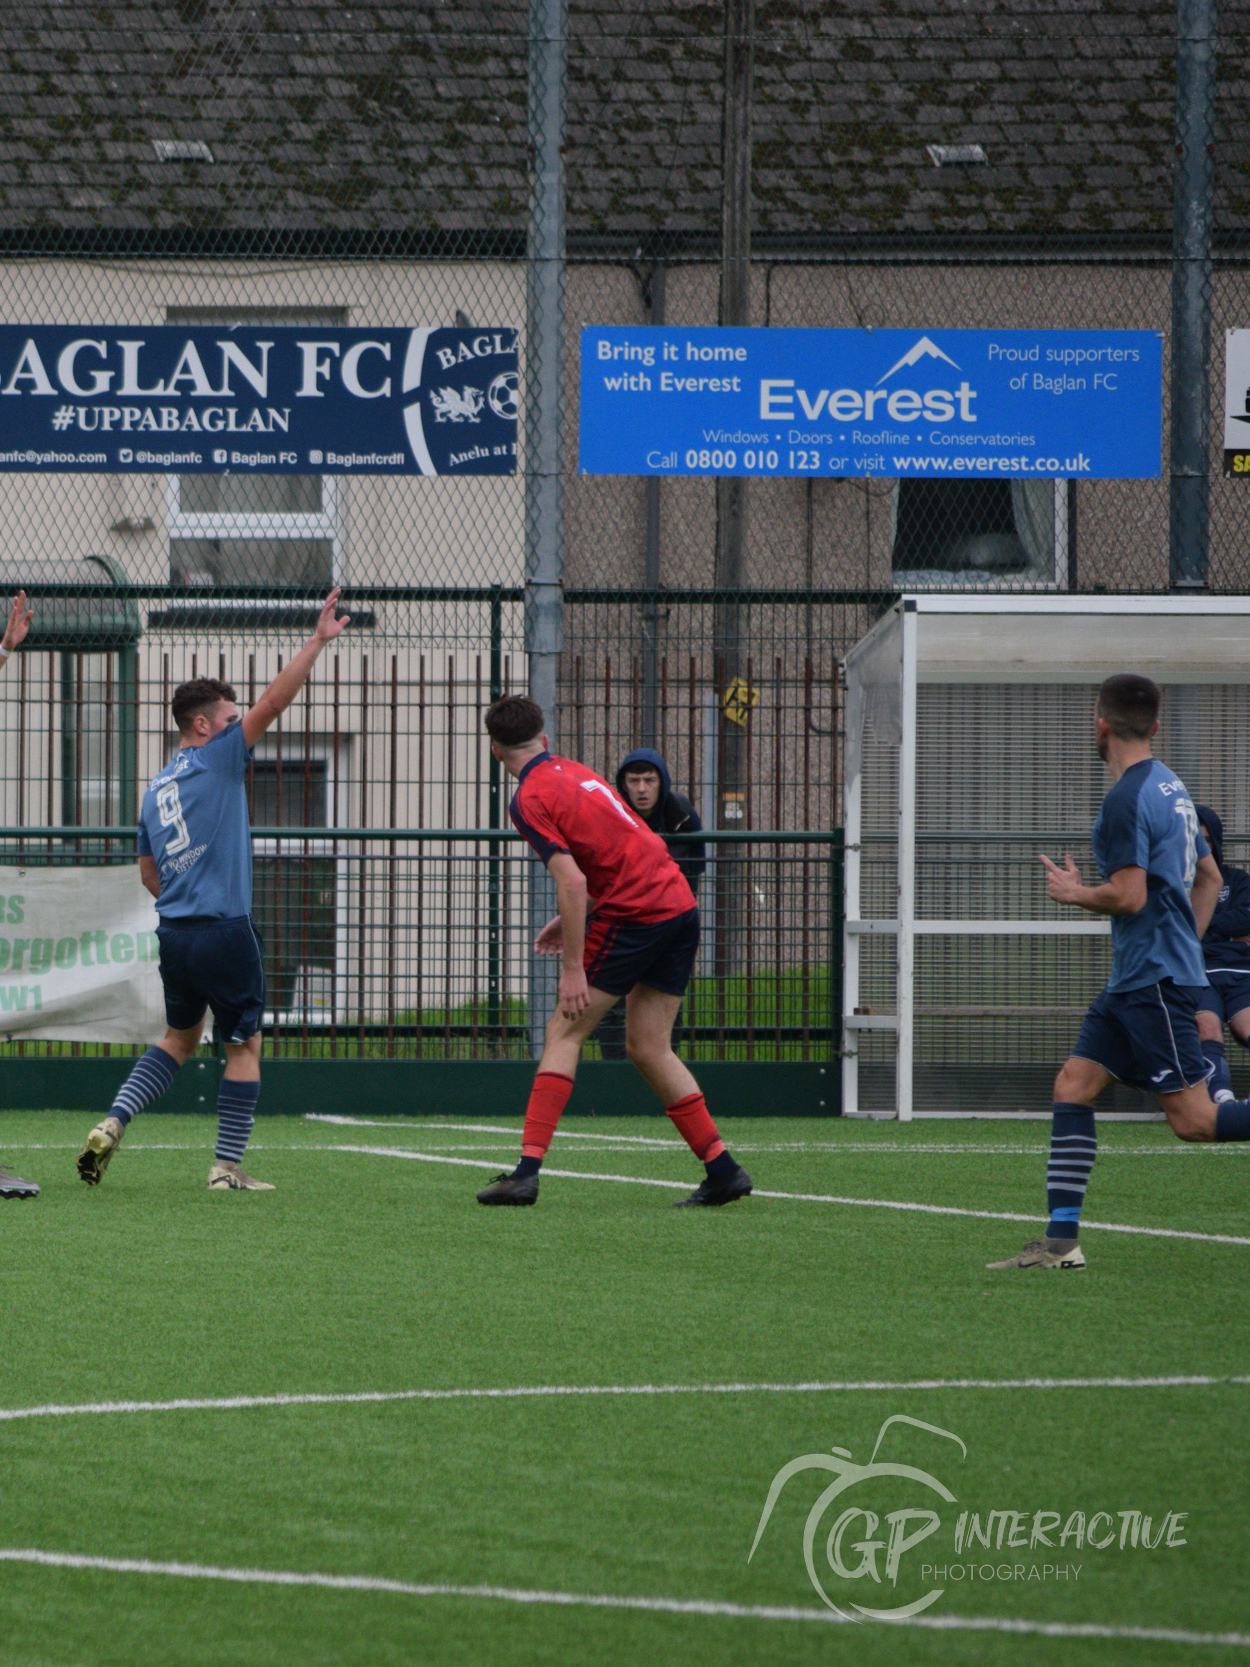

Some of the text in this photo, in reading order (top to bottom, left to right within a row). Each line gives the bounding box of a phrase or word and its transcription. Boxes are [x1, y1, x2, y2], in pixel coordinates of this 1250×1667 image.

[597, 340, 748, 366] Bring it home
[988, 344, 1140, 365] Proud supporters
[295, 341, 392, 398] FC
[604, 372, 742, 392] with Everest
[1010, 373, 1118, 395] of Baglan FC
[760, 379, 977, 422] Everest
[52, 405, 291, 432] #UPPABAGLAN
[702, 429, 1036, 446] Windows Doors Roofline Conservatories
[136, 451, 203, 466] @baglanfc
[231, 452, 298, 466] Baglan FC
[449, 446, 490, 466] Anelu
[493, 444, 507, 456] at
[647, 450, 1091, 471] Call 0800 010 123 or visit www.everest.co.uk
[580, 779, 639, 828] 7
[156, 780, 190, 856] 9
